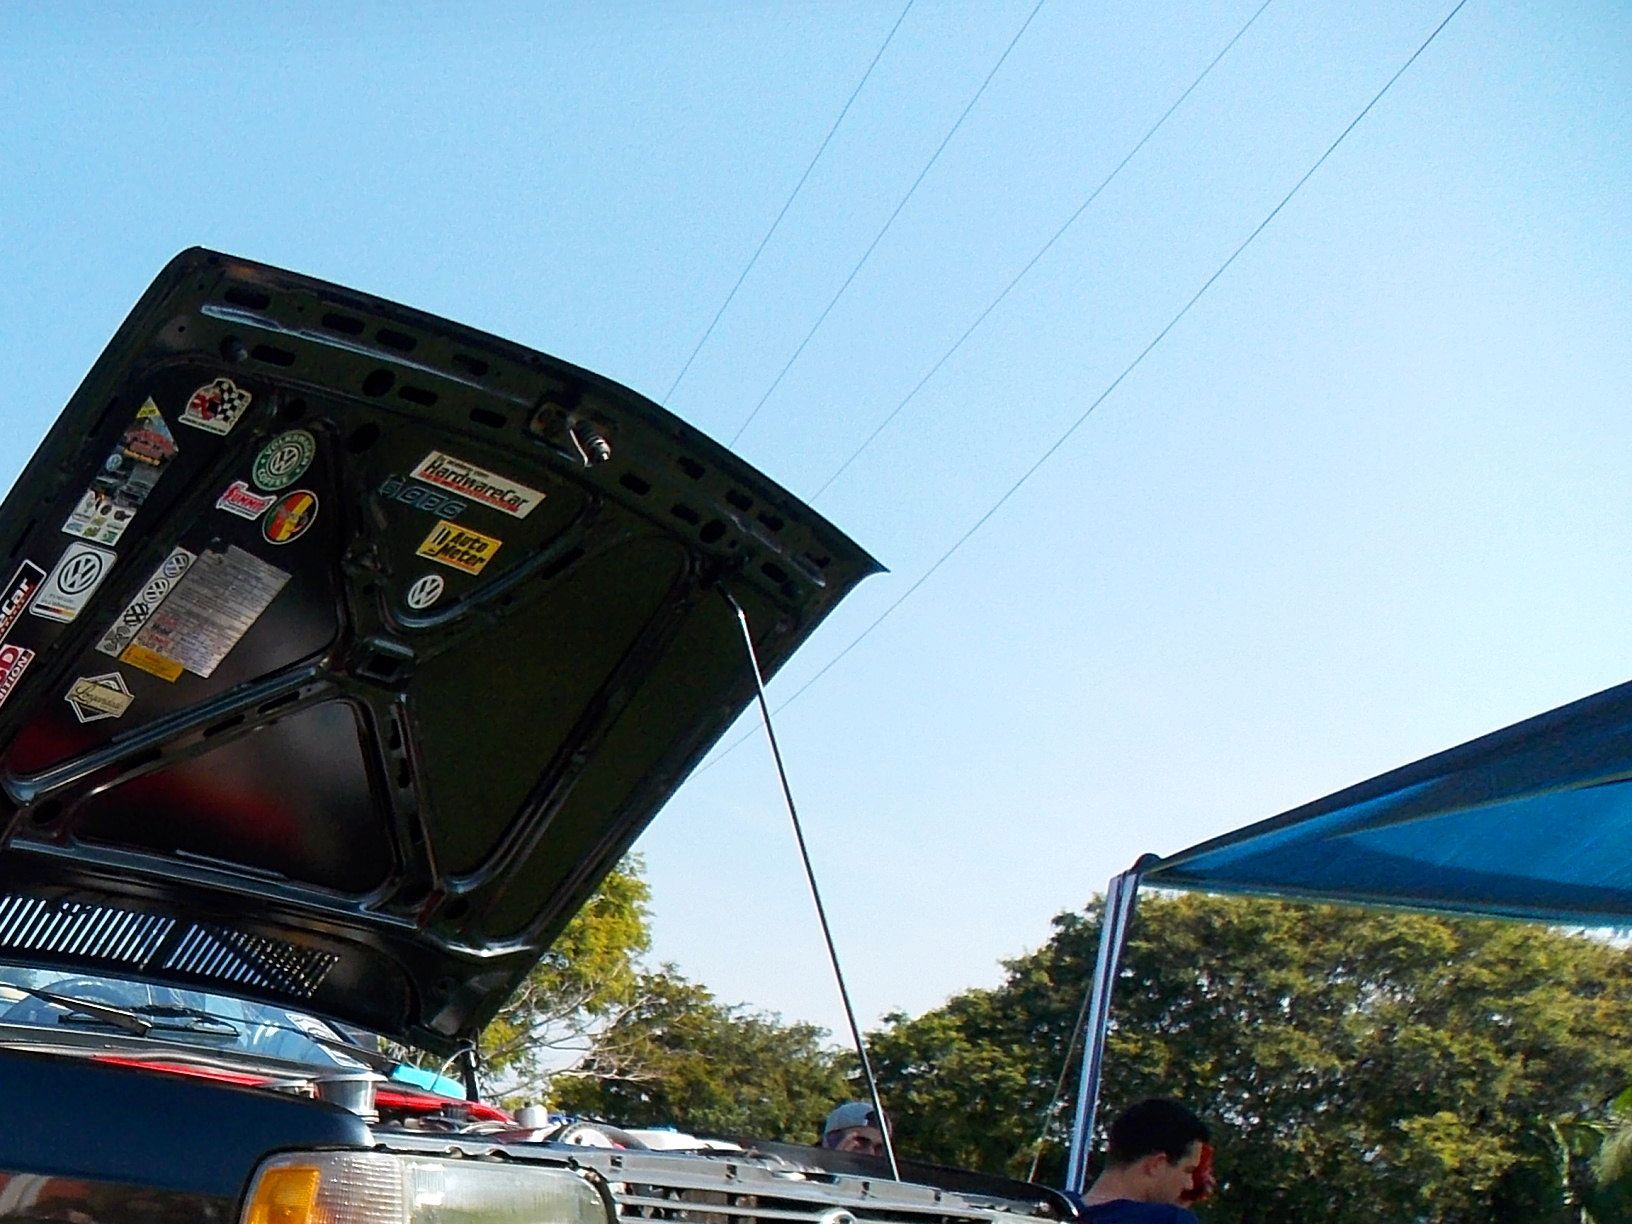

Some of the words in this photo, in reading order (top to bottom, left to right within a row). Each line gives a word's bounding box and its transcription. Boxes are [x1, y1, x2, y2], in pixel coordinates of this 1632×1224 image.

[424, 459, 529, 508] HardwareCar
[449, 531, 489, 553] Auto
[440, 543, 486, 567] Meter
